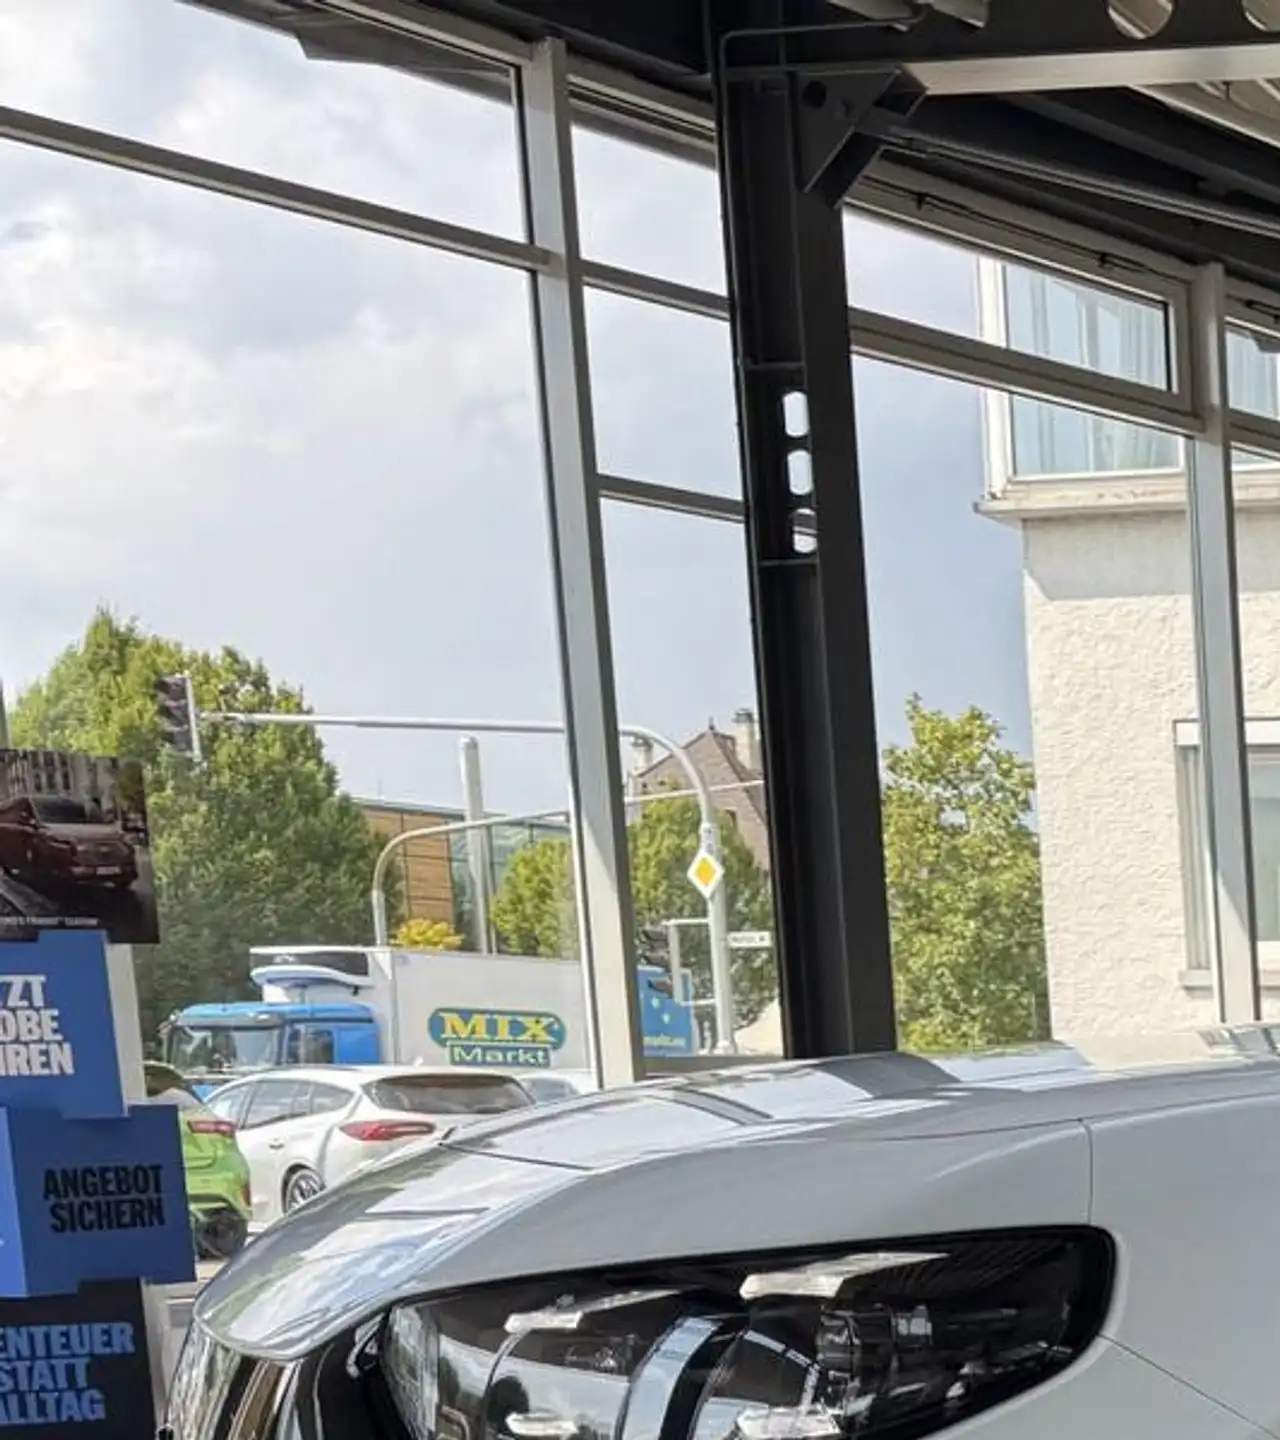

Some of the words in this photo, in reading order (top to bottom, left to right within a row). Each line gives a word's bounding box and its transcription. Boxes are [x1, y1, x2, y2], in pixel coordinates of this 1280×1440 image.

[438, 1012, 557, 1043] MIX
[453, 1047, 546, 1064] Markt
[43, 1164, 163, 1200] ANGEBOT
[51, 1198, 165, 1233] SICHERN
